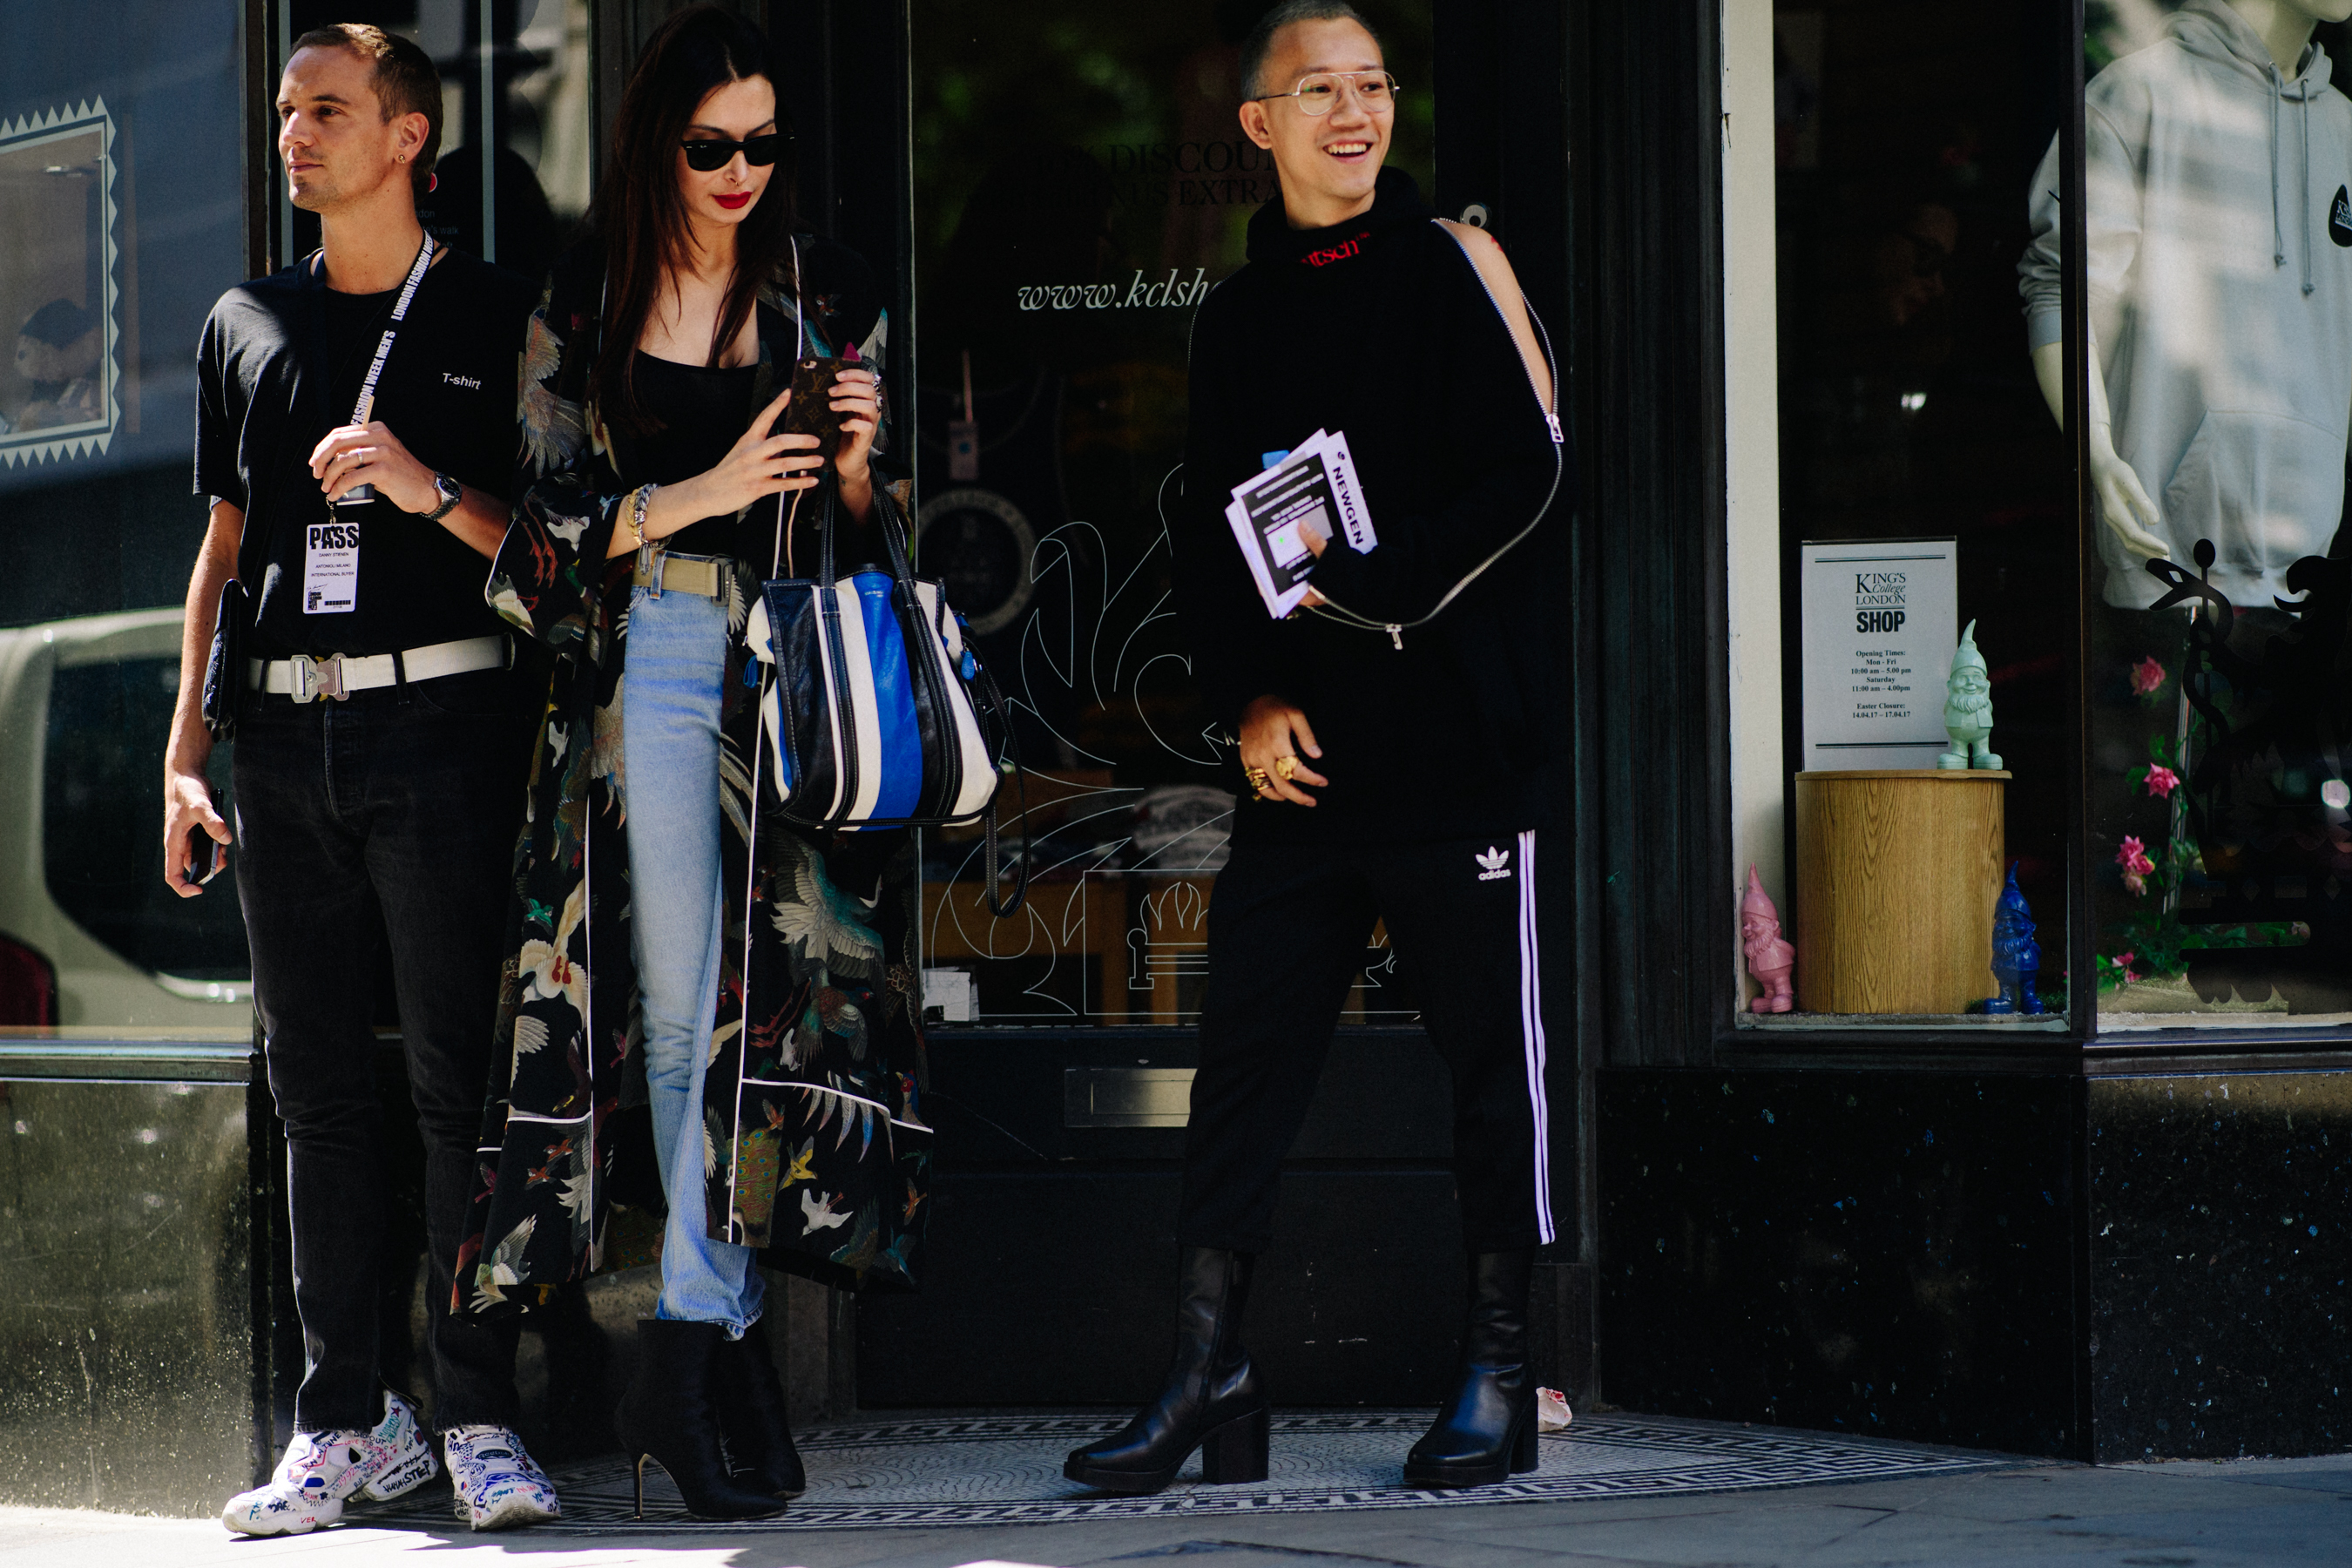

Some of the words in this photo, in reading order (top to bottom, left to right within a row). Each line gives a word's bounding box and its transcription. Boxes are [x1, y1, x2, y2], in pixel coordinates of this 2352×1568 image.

[1109, 141, 1274, 173] DISCOU
[391, 284, 416, 321] LONDON
[407, 250, 431, 286] FASHION
[423, 229, 434, 254] WEE
[364, 358, 385, 386] WEEK
[375, 329, 396, 360] MEN'S
[443, 372, 482, 390] T-shirt
[1333, 466, 1363, 544] NEWGEN
[309, 525, 359, 550] PASS
[1855, 572, 1906, 594] KING'S
[1872, 584, 1906, 595] College
[1855, 594, 1906, 605] LONDON
[1856, 611, 1906, 633] SHOP
[1478, 868, 1511, 881] adidas
